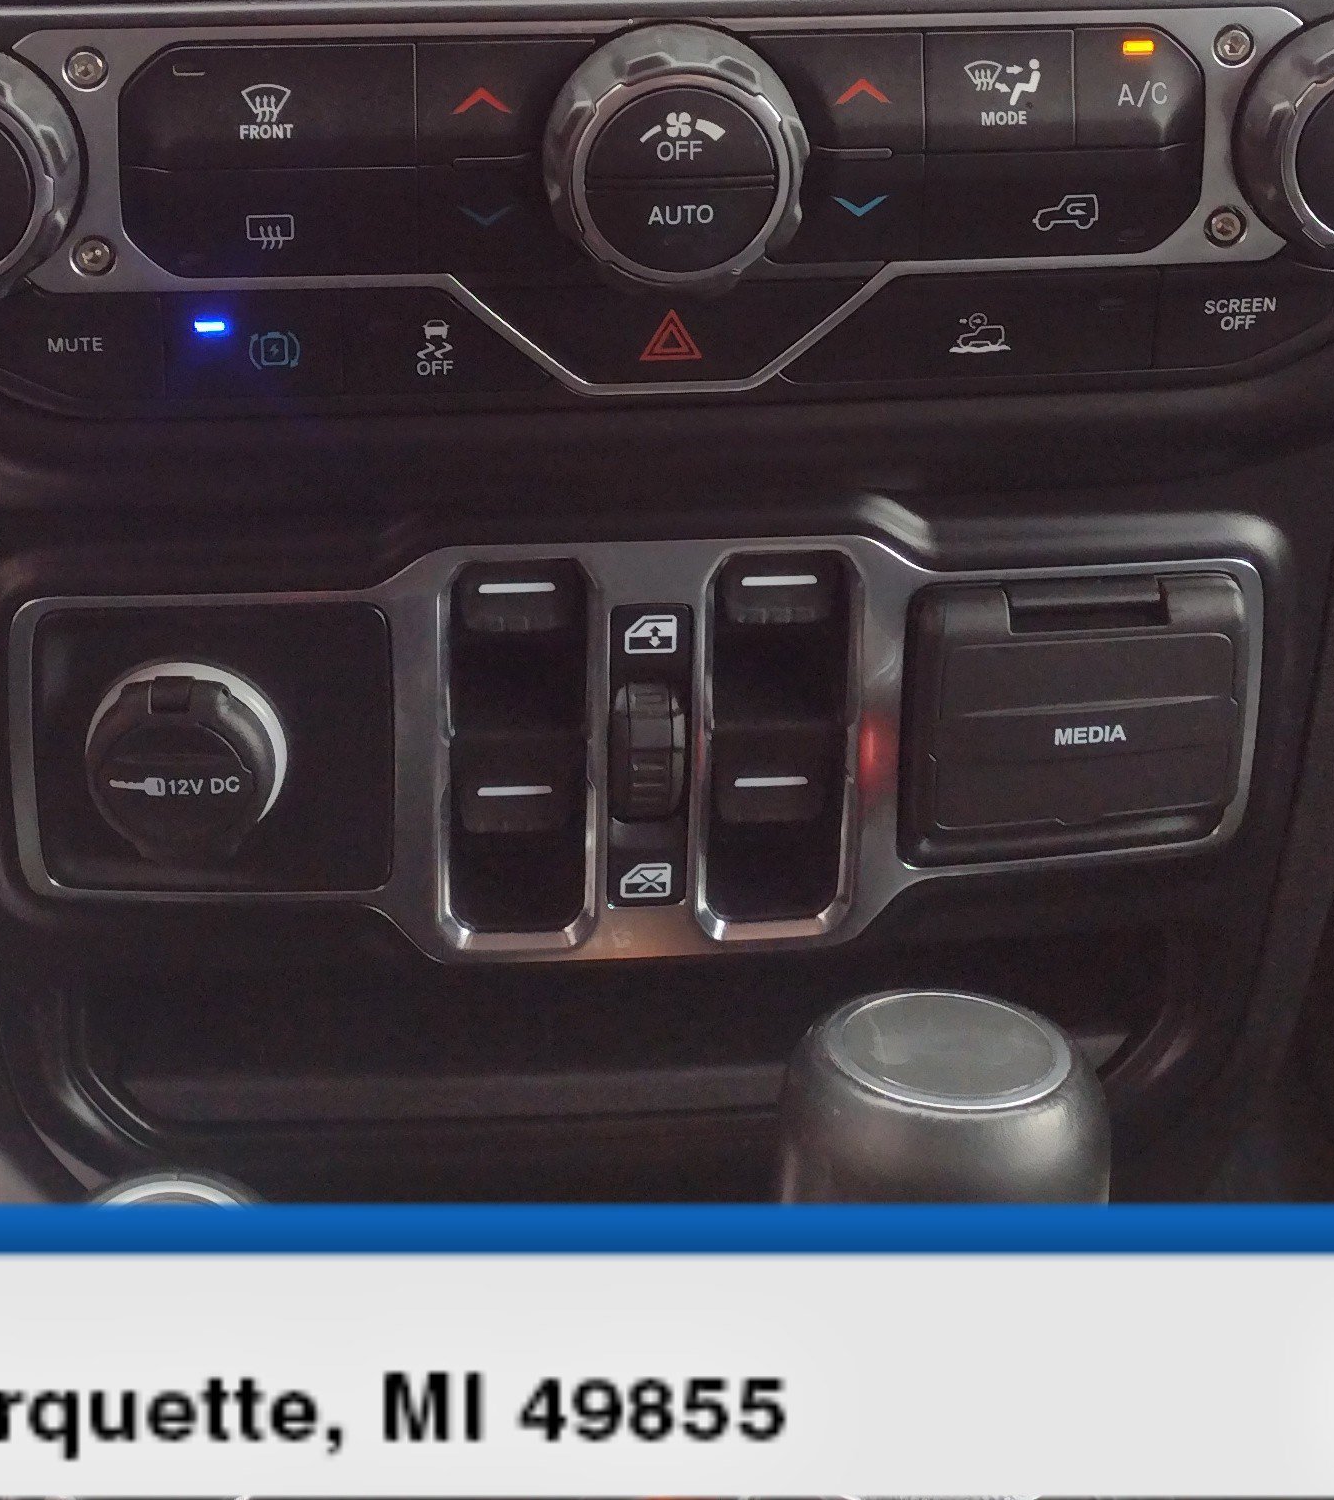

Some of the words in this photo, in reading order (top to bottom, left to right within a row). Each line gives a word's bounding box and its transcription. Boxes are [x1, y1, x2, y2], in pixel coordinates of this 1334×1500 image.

[1117, 82, 1168, 107] A/C
[980, 110, 1028, 127] MODE
[239, 123, 294, 140] FRONT
[657, 140, 703, 162] OFF
[647, 204, 714, 226] AUTO
[1204, 297, 1277, 315] SCREEN
[1220, 314, 1256, 331] OFF
[47, 336, 104, 354] MUTE
[416, 360, 454, 377] OFF
[1053, 724, 1127, 746] MEDIA
[167, 778, 203, 795] 12V
[210, 776, 241, 794] DC
